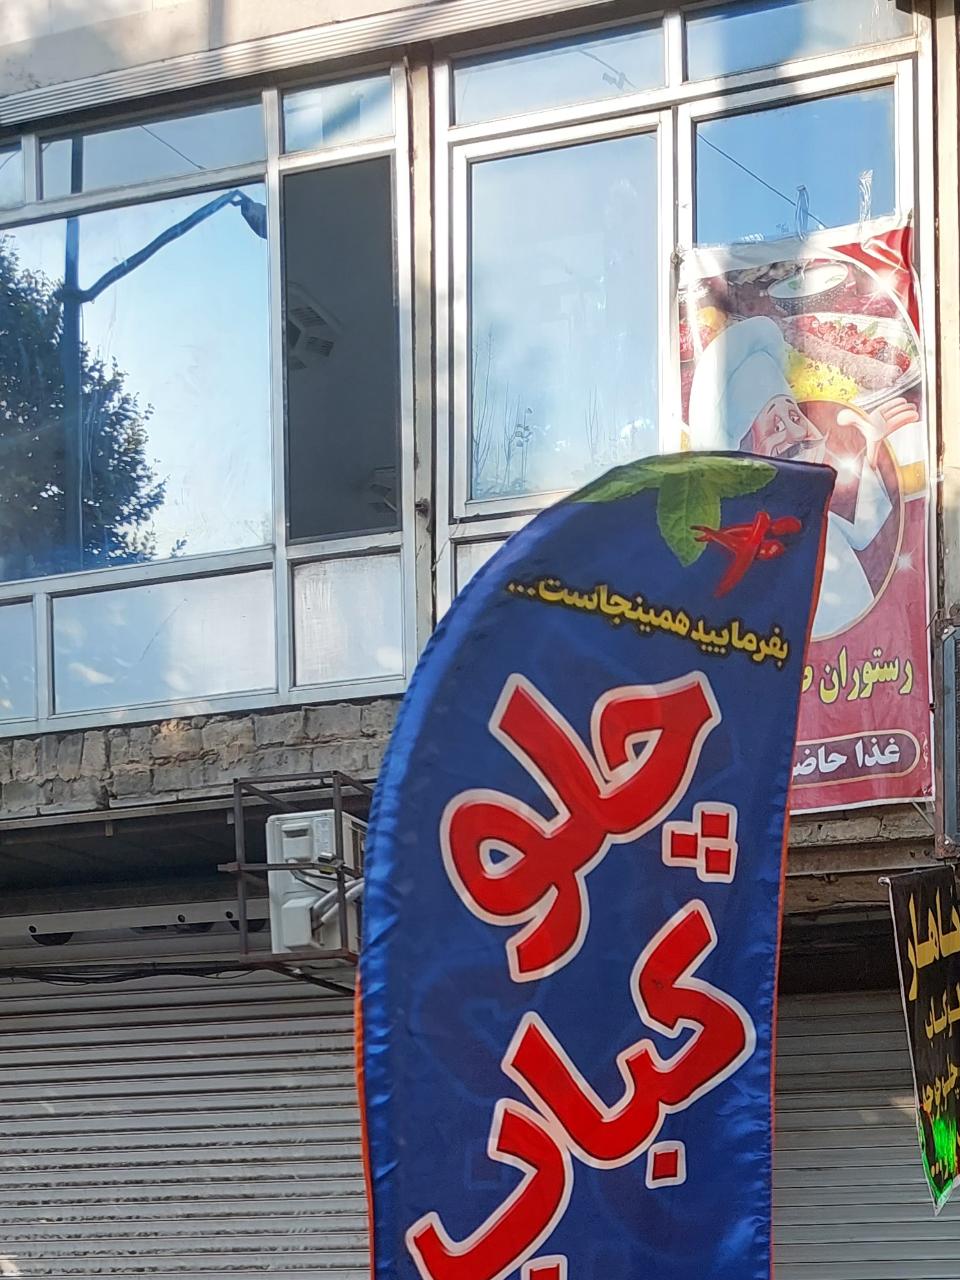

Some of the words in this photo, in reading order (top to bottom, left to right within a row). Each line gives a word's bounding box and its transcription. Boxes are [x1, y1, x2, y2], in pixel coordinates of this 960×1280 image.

[691, 619, 790, 668] بفرمایید
[819, 645, 914, 704] رستوران
[792, 743, 848, 777] حاض
[854, 737, 901, 768] غذا
[440, 671, 738, 982] چلو
